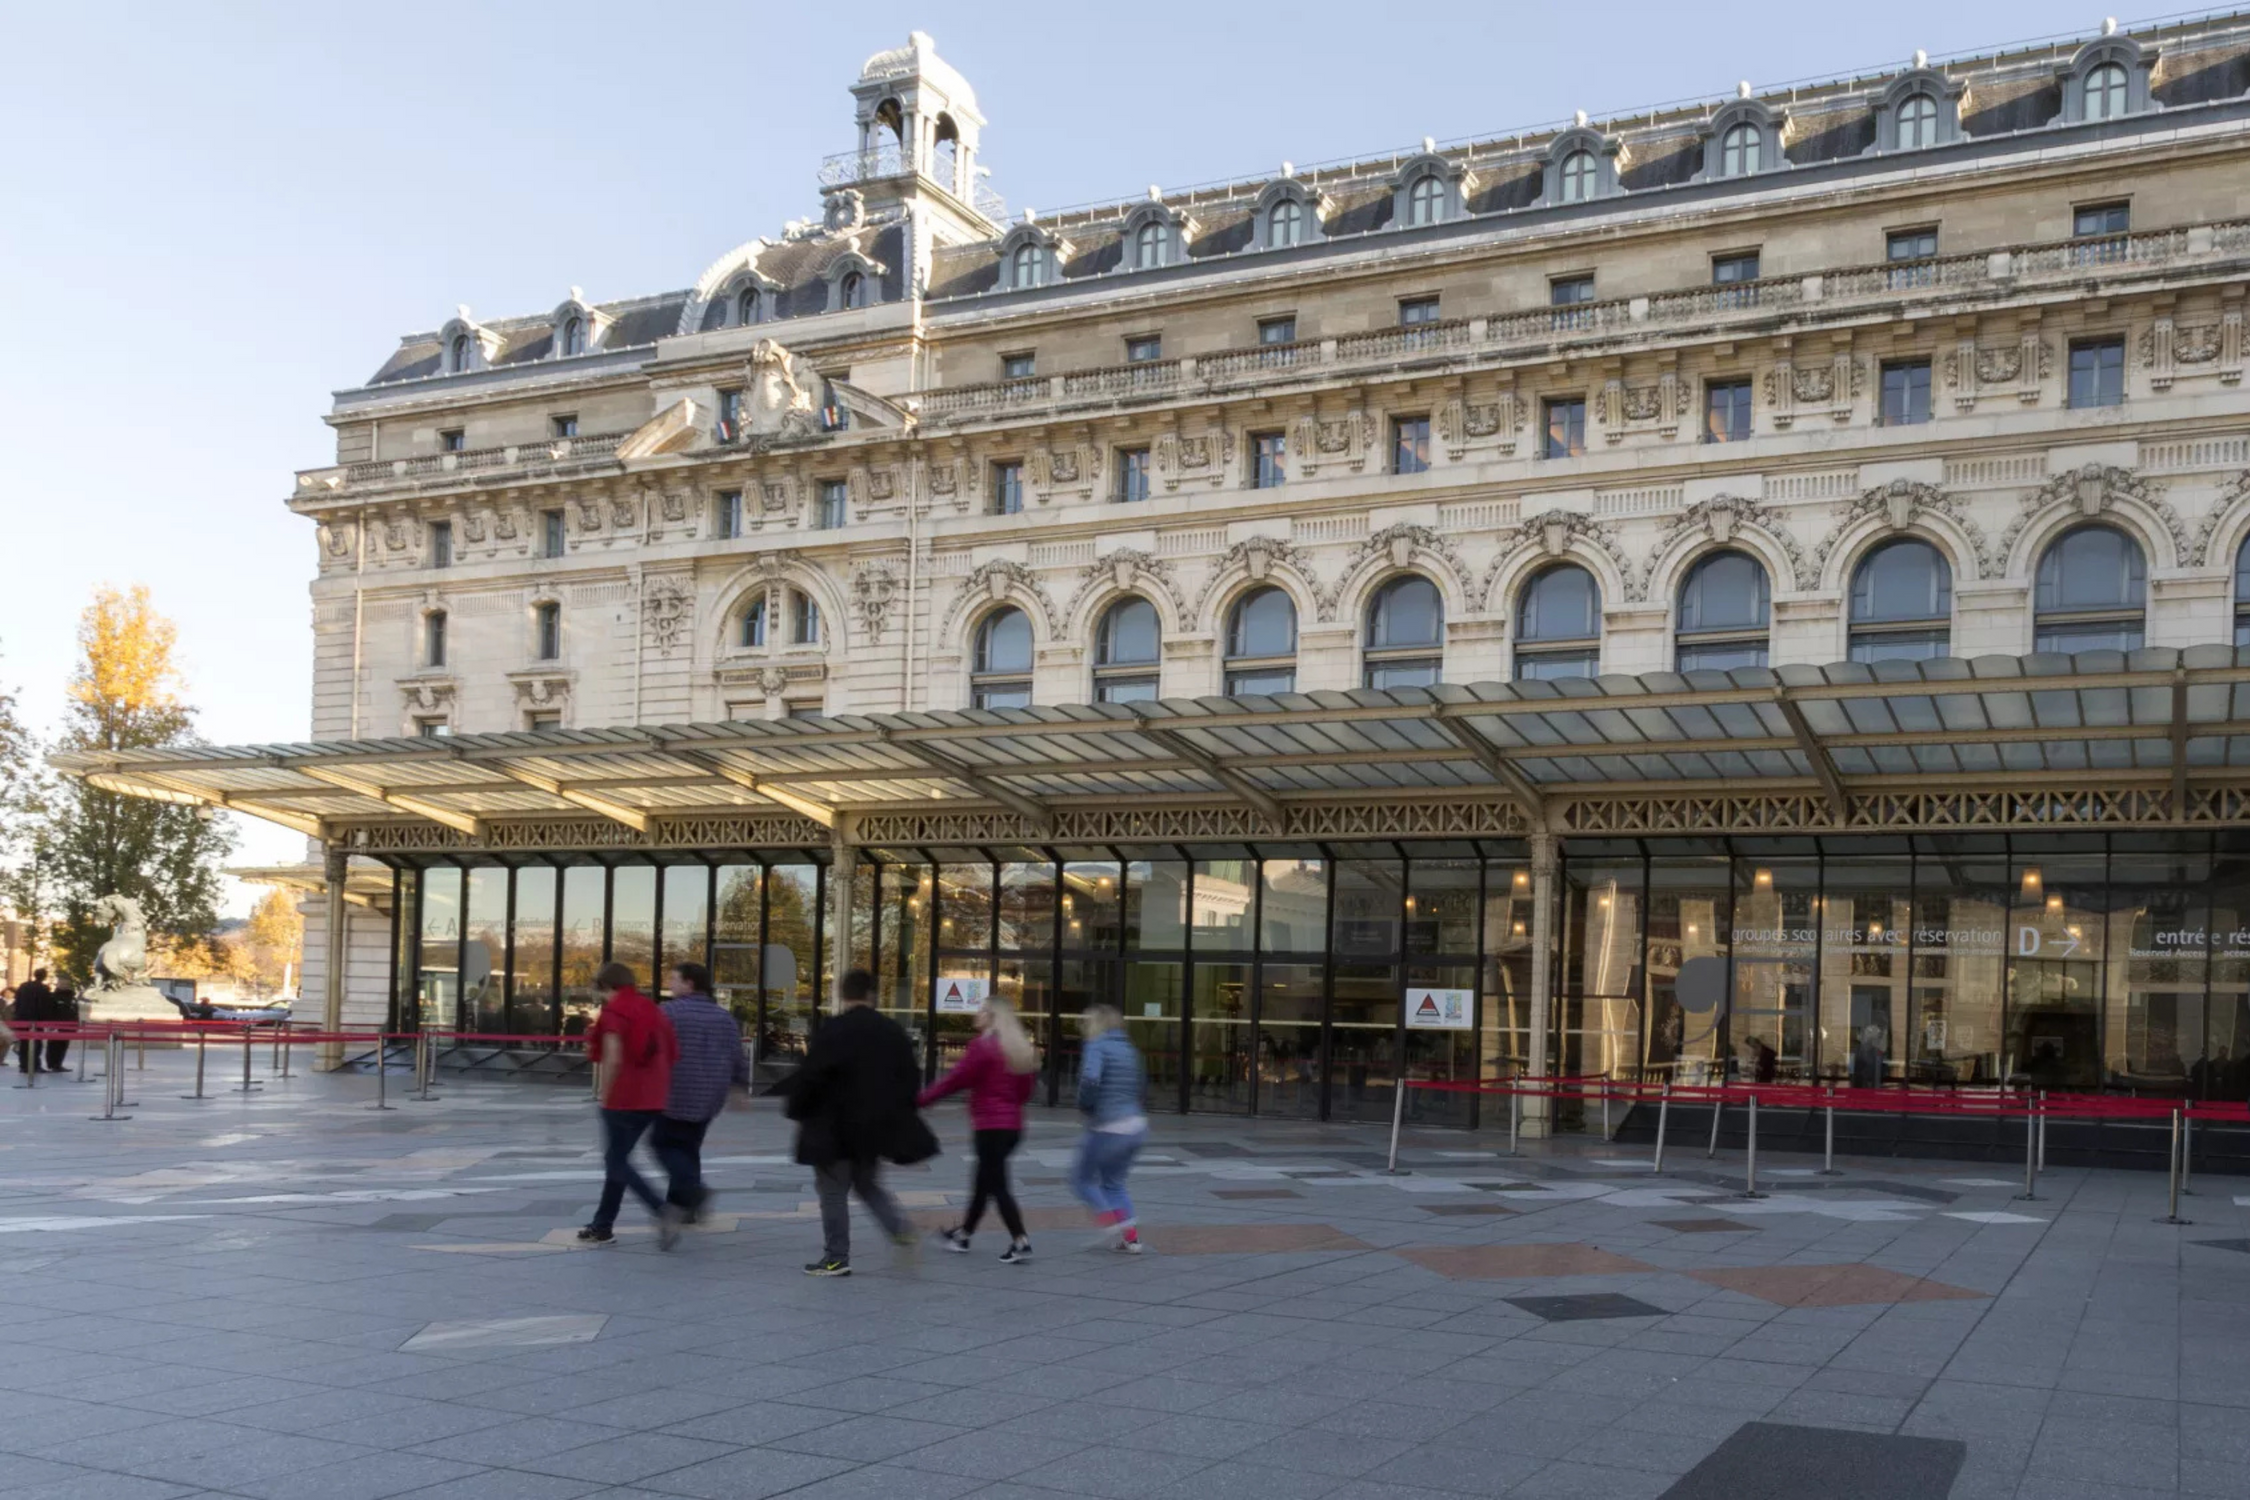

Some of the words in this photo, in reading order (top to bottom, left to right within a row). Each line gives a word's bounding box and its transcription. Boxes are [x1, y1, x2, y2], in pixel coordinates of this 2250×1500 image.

[1732, 928, 1788, 945] groupes
[1792, 925, 1862, 942] scoaires
[1867, 929, 1904, 942] avec
[1913, 925, 2002, 942] réservation
[2019, 926, 2040, 956] D
[2156, 926, 2222, 945] entrée
[2129, 947, 2172, 957] Reserved
[2174, 948, 2208, 958] Access
